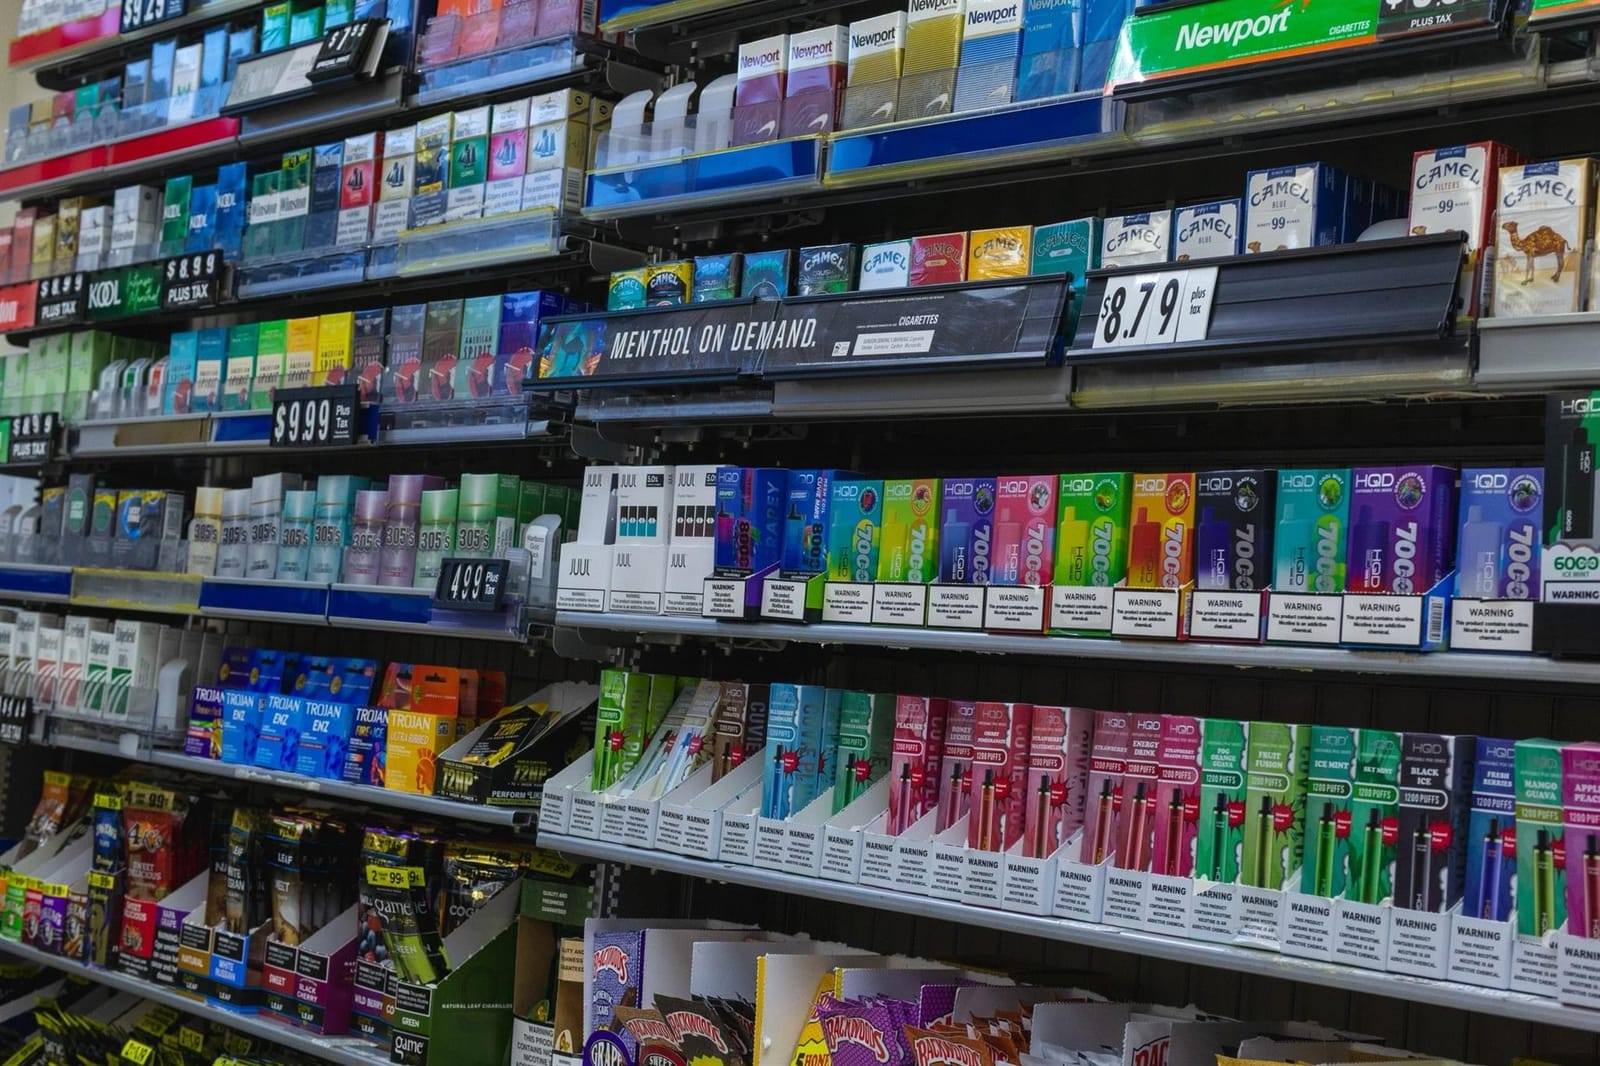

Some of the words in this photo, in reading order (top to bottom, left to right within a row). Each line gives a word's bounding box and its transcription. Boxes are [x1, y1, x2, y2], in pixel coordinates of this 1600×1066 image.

[968, 4, 1017, 25] Newport
[1410, 16, 1434, 28] PLUS
[1435, 13, 1452, 24] TAX
[1175, 6, 1292, 52] Newport
[1329, 20, 1370, 36] CIGARETTES
[852, 27, 896, 49] Newport
[791, 40, 832, 60] Newport
[741, 50, 779, 69] Newport
[1416, 162, 1480, 190] CAMEL
[1434, 182, 1460, 191] FILTERS
[1250, 181, 1309, 207] CAMEL
[1503, 180, 1576, 208] CAMEL
[1272, 200, 1287, 208] BLUE
[1438, 199, 1454, 213] 99
[1179, 217, 1233, 242] CAMEL
[1272, 217, 1285, 229] 99
[1107, 229, 1162, 252] CAMEL
[1199, 235, 1212, 244] BLUE
[973, 237, 1025, 259] CAMEL
[804, 251, 844, 271] CAMEL
[863, 251, 906, 273] CAMEL
[650, 271, 679, 288] CAMEL
[88, 279, 122, 309] KOOL
[168, 286, 190, 303] PLUS
[191, 283, 208, 300] TAX
[1190, 286, 1206, 301] plus
[41, 304, 61, 319] PLUS
[61, 300, 76, 316] TAX
[1189, 304, 1201, 315] tax
[898, 314, 939, 326] CIGARETTES
[465, 334, 492, 345] AMERICAN
[610, 326, 692, 359] MENTHOL
[699, 323, 727, 353] ON
[731, 318, 817, 352] DEMAND.
[321, 349, 344, 358] AMERICAN
[464, 345, 492, 360] SPIRIT
[336, 404, 350, 417] Plus
[336, 417, 349, 428] Tax
[13, 442, 33, 456] PLUS
[33, 442, 46, 455] TAX
[586, 473, 602, 487] JUUL
[620, 473, 637, 487] JUUL
[678, 472, 695, 487] JUUL
[1062, 480, 1093, 492] HQD
[1199, 478, 1232, 491] HQD
[1282, 475, 1314, 488] HQD
[1356, 473, 1394, 488] HQD
[833, 486, 858, 496] HQD
[999, 481, 1027, 493] HQD
[195, 523, 217, 541] 305's
[252, 523, 276, 541] 305's
[283, 528, 309, 547] 305's
[315, 525, 341, 544] 305's
[421, 529, 450, 550] 305's
[459, 528, 489, 550] 305's
[616, 552, 631, 567] JUUL
[1554, 556, 1599, 570] 6000
[569, 558, 590, 576] JUUL
[485, 571, 499, 584] Plus
[485, 584, 496, 596] Tax
[1208, 600, 1243, 608] WARNING
[1284, 603, 1322, 611] WARNING
[1359, 603, 1400, 612] WARNING
[1470, 608, 1514, 617] WARNING
[226, 693, 254, 707] TROJAN
[269, 696, 300, 712] TROJAN
[232, 710, 245, 721] ENZ
[306, 702, 341, 718] TROJAN
[356, 708, 389, 723] TROJAN
[273, 713, 289, 725] ENZ
[392, 714, 431, 730] TROJAN
[1137, 719, 1160, 730] HQD
[312, 720, 328, 732] ENZ
[356, 726, 369, 736] FIRE
[1169, 724, 1194, 735] HQD
[1133, 740, 1159, 749] ENERGY
[1134, 749, 1156, 757] DRINK
[1258, 751, 1281, 760] FRUIT
[1255, 760, 1283, 769] FUSION
[1315, 760, 1328, 768] ICE
[1330, 761, 1349, 770] MINT
[1411, 767, 1439, 777] BLACK
[1487, 771, 1510, 780] FRESH
[1206, 773, 1219, 783] 1200
[1220, 773, 1236, 785] PUFFS
[1417, 777, 1432, 785] ICE
[1524, 780, 1558, 791] MANGO
[1312, 782, 1327, 792] 1200
[1327, 782, 1344, 794] PUFFS
[1358, 788, 1372, 798] 1200
[1373, 789, 1391, 800] PUFFS
[1404, 792, 1419, 803] 1200
[1420, 793, 1440, 805] PUFFS
[1476, 795, 1493, 807] 1200
[1493, 796, 1512, 809] PUFFS
[1525, 790, 1557, 801] GUAVA
[968, 858, 998, 869] WARNING
[1008, 864, 1039, 875] WARNING
[372, 870, 378, 882] 2
[1060, 870, 1092, 883] WARNING
[375, 899, 412, 924] game
[1291, 902, 1330, 917] WARNING
[1342, 910, 1381, 925] WARNING
[1395, 918, 1436, 932] WARNING
[1457, 926, 1500, 941] WARNING
[218, 959, 234, 970] WHITE
[186, 980, 198, 990] LEAF
[268, 974, 285, 986] SWEET
[299, 982, 316, 994] BLACK
[219, 992, 231, 1000] LEAF
[296, 990, 317, 1003] CHERRY
[354, 994, 366, 1006] WILD
[366, 998, 383, 1010] BERRY
[271, 1002, 283, 1011] LEAF
[301, 1011, 313, 1020] LEAF
[361, 1024, 374, 1033] LEAF
[402, 1017, 420, 1028] GREEN
[523, 1034, 533, 1042] THIS
[666, 1011, 728, 1054] BACKWOODS
[825, 1016, 889, 1063] BACKWOODS
[395, 1036, 424, 1060] game
[517, 1042, 541, 1054] CONTAINS
[523, 1053, 547, 1064] NICOTINE
